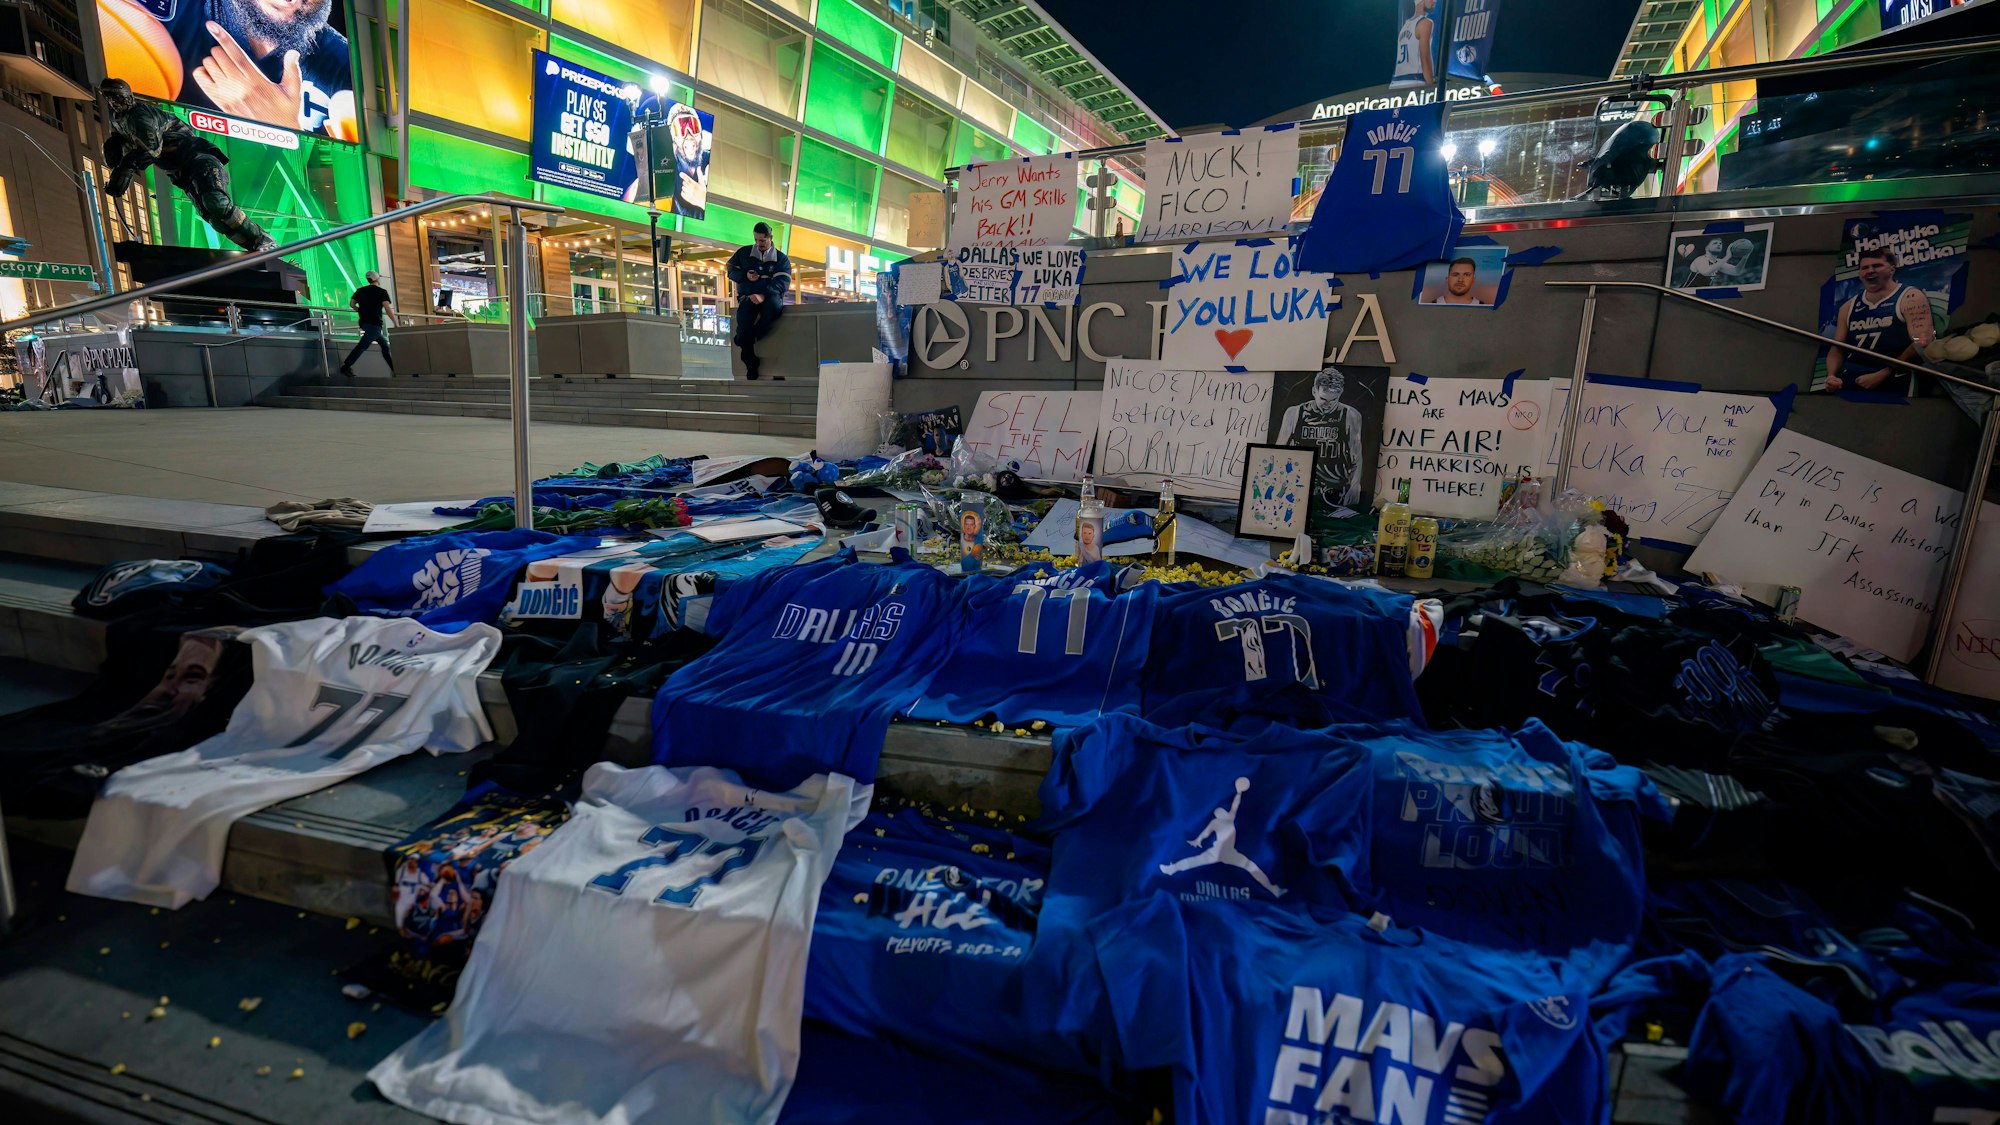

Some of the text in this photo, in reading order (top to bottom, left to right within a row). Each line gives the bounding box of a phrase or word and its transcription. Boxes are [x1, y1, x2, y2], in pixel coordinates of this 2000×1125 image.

[1453, 10, 1491, 42] LOUD!
[561, 67, 626, 100] PRIZEPICKS
[567, 89, 607, 123] PLAY $5
[1312, 85, 1482, 120] American Airlnes
[195, 115, 294, 146] BIG OUTDOOR
[560, 112, 611, 146] GET $50
[1366, 120, 1420, 146] DONČIĆ
[551, 131, 616, 170] INSTANTLY
[1166, 138, 1263, 187] NUCK!
[969, 163, 1061, 191] Jerry Wants
[1363, 147, 1415, 195] 77
[971, 198, 993, 214] his
[1000, 189, 1027, 209] GM
[1159, 179, 1250, 222] FICO!
[1140, 216, 1275, 243] HARRISON!
[1854, 224, 1940, 252] Halleluka
[51, 265, 87, 276] Park
[960, 247, 1018, 266] DALLAS
[1023, 250, 1079, 268] WE LOVE
[1178, 251, 1231, 283] WE
[963, 267, 1015, 281] DESERVES
[1034, 269, 1072, 288] LUKA
[960, 285, 1010, 302] ETTER
[1021, 285, 1041, 303] 77
[1244, 287, 1327, 325] LUKA
[979, 302, 1126, 362] PNC
[1855, 331, 1883, 351] 77
[91, 347, 134, 369] PNC PLAZA
[984, 392, 1082, 434] SELL
[1386, 388, 1509, 407] LLAS MAVS
[1723, 404, 1755, 415] MAV
[1112, 399, 1216, 436] betrayed
[1422, 407, 1446, 420] ARE
[1011, 433, 1043, 447] THE
[1301, 426, 1340, 440] DALLAS
[1381, 428, 1502, 453] UNFAIR!
[1102, 427, 1176, 477] BURN
[1183, 442, 1219, 477] IN
[1410, 455, 1508, 477] HARRISON
[1516, 464, 1532, 478] IS
[1659, 455, 1697, 479] for
[1422, 478, 1486, 498] THERE!
[1776, 451, 1845, 492] 2/1/25
[1860, 480, 1884, 503] is
[1744, 507, 1864, 563] than JFK
[1759, 479, 1951, 563] Day in Dallas History
[518, 584, 579, 617] DONČIĆ
[772, 602, 906, 644] DALLAS
[1012, 584, 1091, 656] 77
[1214, 614, 1320, 691] 77
[283, 682, 409, 761] 77
[587, 825, 769, 909] 77
[1195, 879, 1250, 900] DALLAS
[886, 936, 953, 954] PLAYOFFS
[1284, 985, 1505, 1088] MAVS
[1268, 1043, 1436, 1125] FAN
